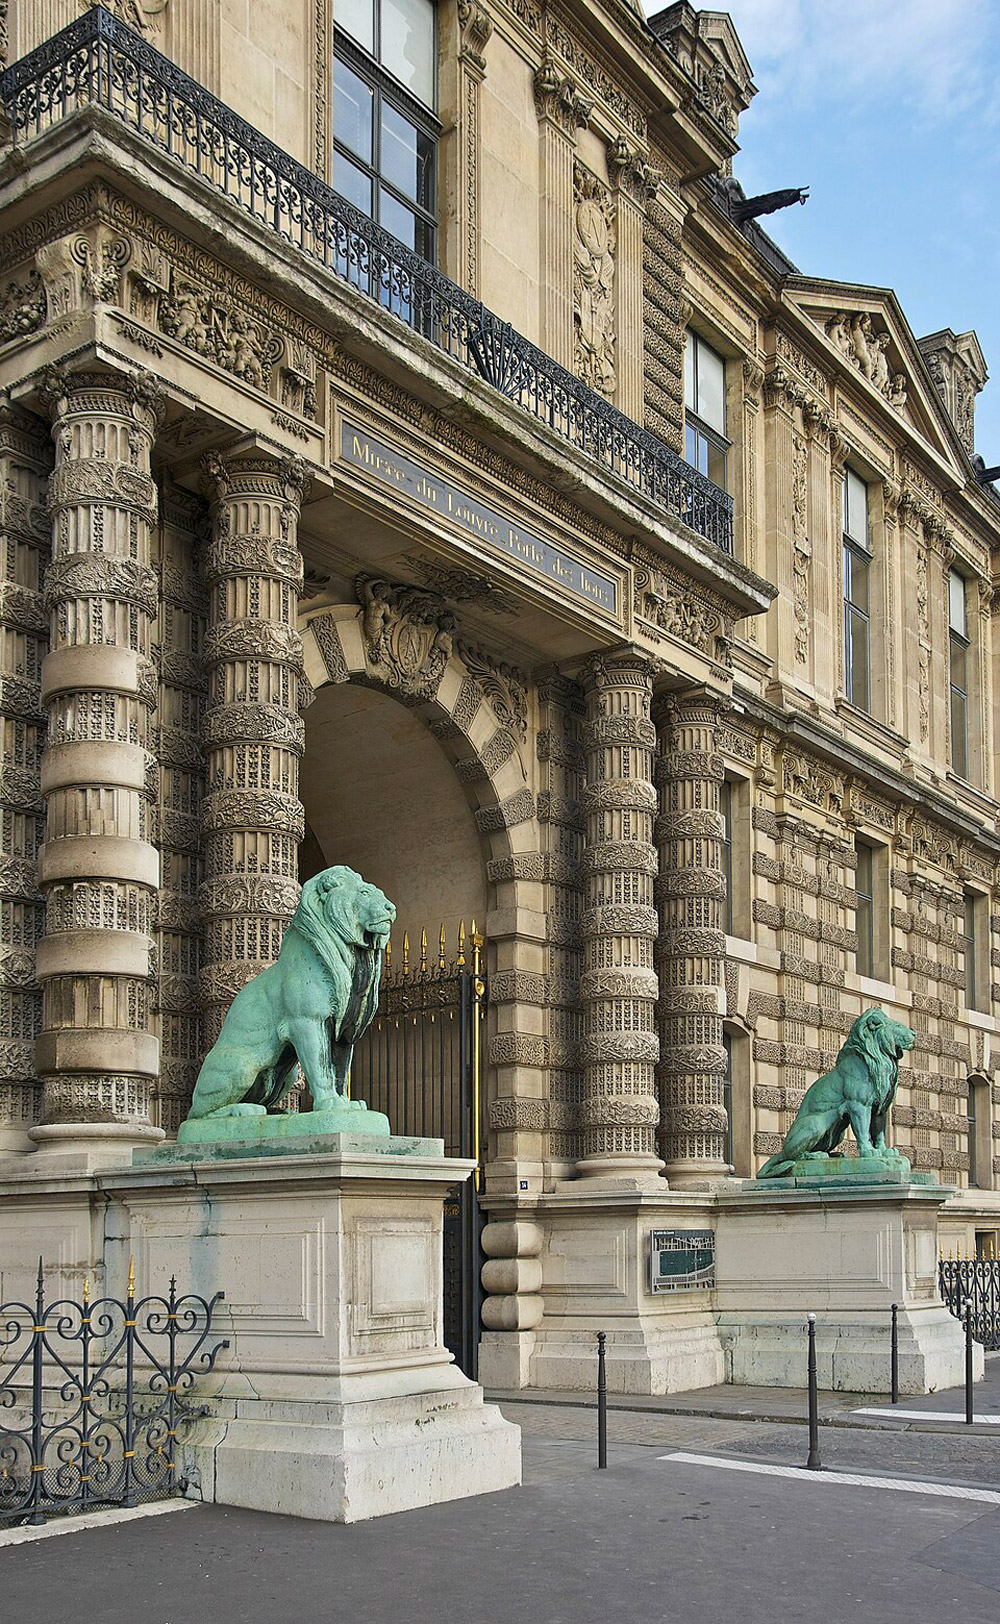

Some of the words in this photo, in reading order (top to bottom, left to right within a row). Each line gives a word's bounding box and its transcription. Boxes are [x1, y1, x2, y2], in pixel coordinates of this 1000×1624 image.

[417, 477, 436, 501] du
[448, 493, 498, 536] Louvre
[508, 529, 544, 564] Porte
[552, 557, 573, 583] des
